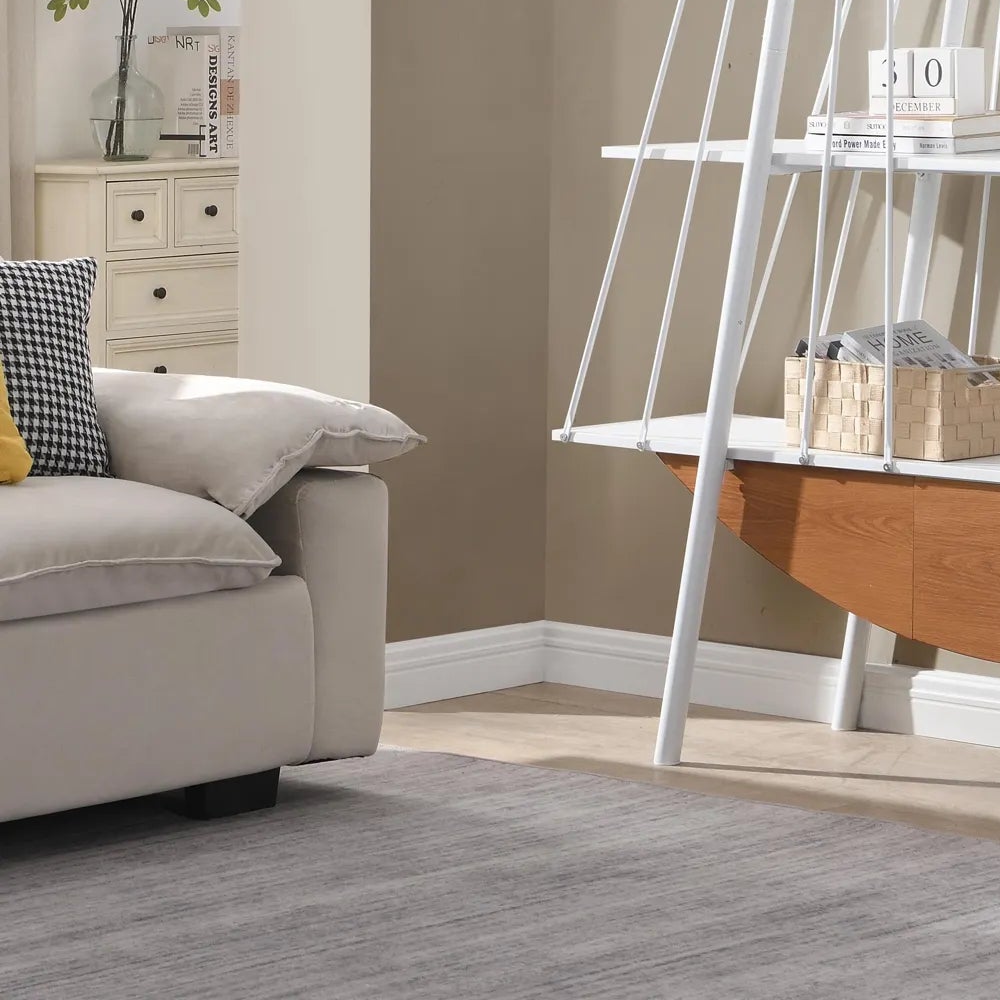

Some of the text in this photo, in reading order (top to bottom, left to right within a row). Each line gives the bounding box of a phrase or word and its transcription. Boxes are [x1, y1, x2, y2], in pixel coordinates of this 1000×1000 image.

[208, 55, 218, 154] DESIGNS ART
[893, 102, 941, 112] ECEMBER
[832, 139, 897, 151] ord Power Made Ey
[867, 331, 933, 352] HOME
